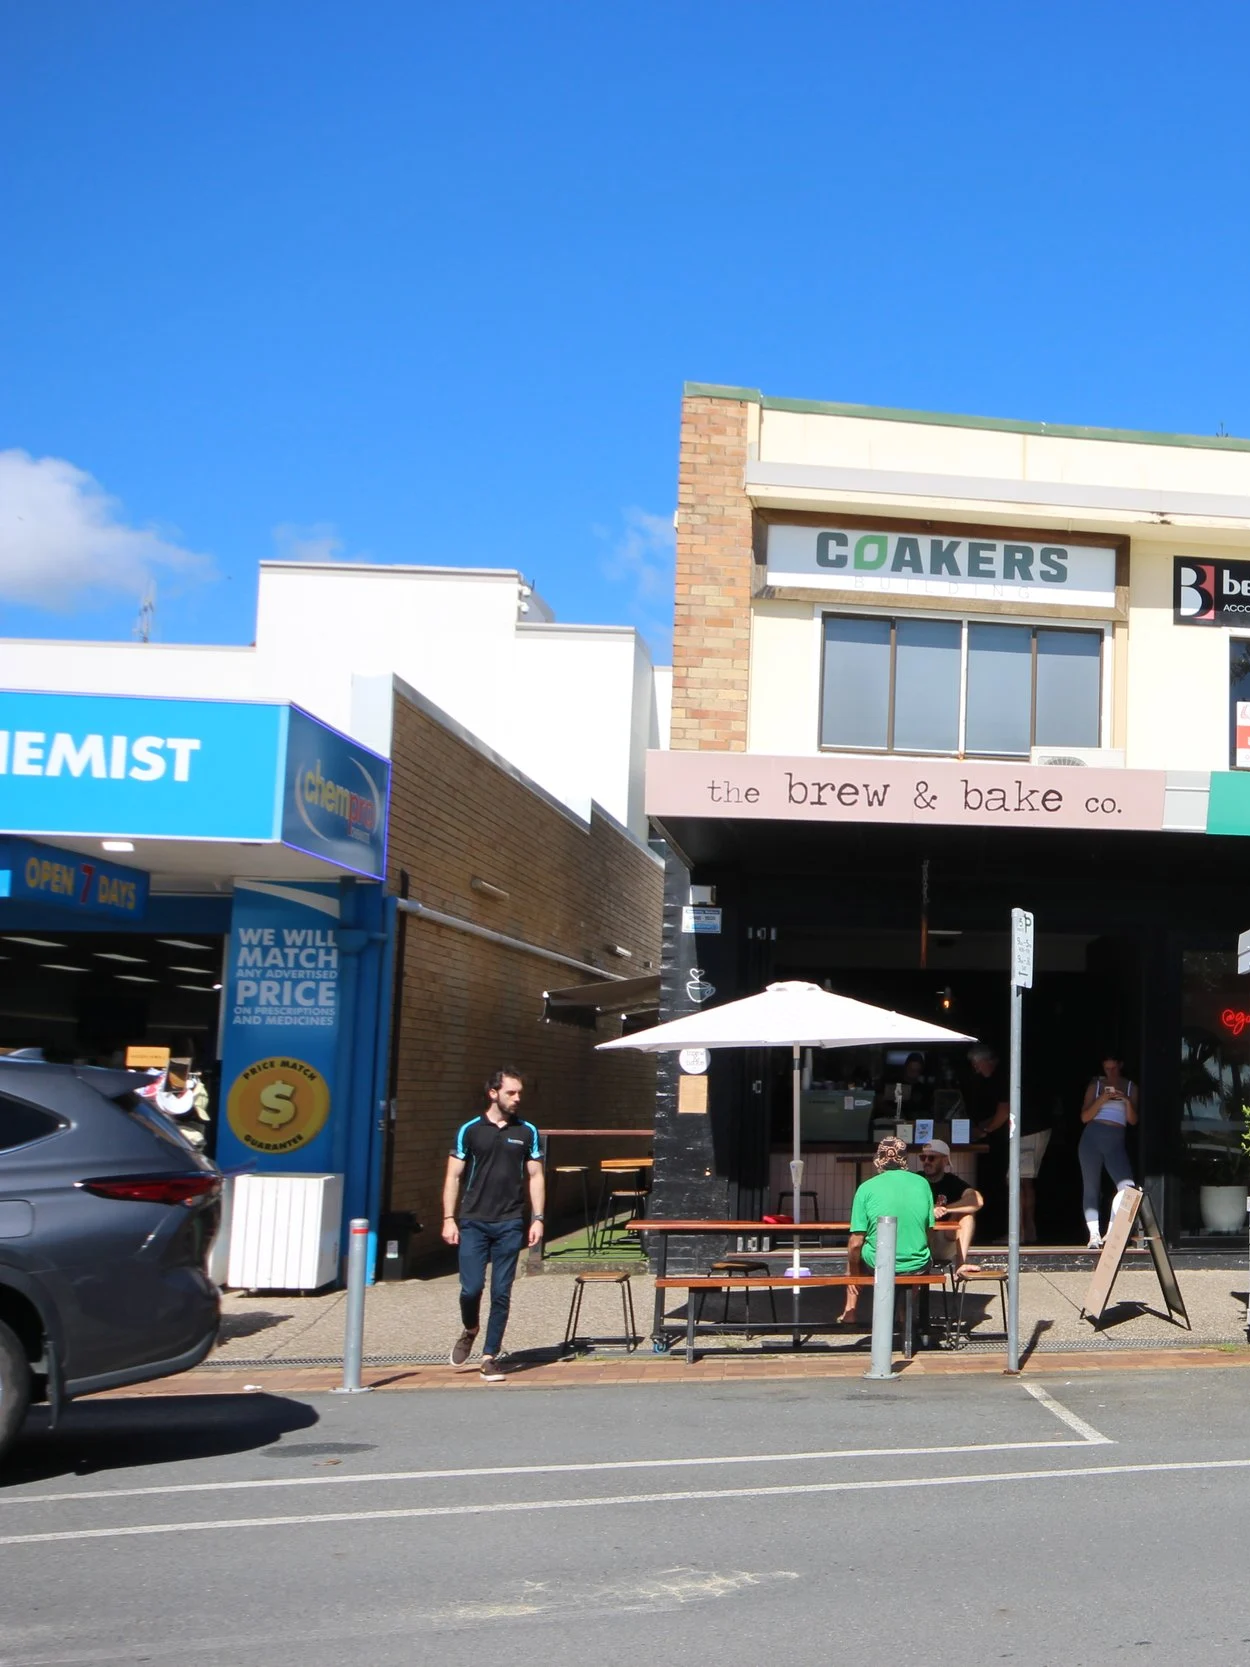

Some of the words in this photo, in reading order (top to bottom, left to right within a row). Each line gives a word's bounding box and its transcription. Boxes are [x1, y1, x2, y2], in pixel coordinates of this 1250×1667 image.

[816, 531, 1068, 583] COAKERS
[854, 576, 1031, 599] BUILDING
[707, 780, 760, 803] the
[784, 772, 890, 807] brew
[913, 781, 938, 810] &
[960, 779, 1063, 812] bake
[1085, 797, 1122, 814] co.
[25, 857, 75, 896] OPEN
[81, 863, 95, 904] 7
[98, 875, 136, 909] DAYS
[239, 928, 275, 945] WE
[283, 929, 338, 947] WILL
[238, 947, 338, 969] MATCH
[236, 969, 262, 978] ANY
[265, 969, 338, 979] ADVERTISED
[236, 981, 336, 1006] PRICE
[232, 1016, 262, 1025] AND
[265, 1016, 333, 1026] MEDICINES
[233, 1007, 251, 1015] ON
[254, 1007, 335, 1016] PRESCRIPTIONS
[243, 1061, 275, 1080] PRICE
[280, 1060, 317, 1081] MATCH
